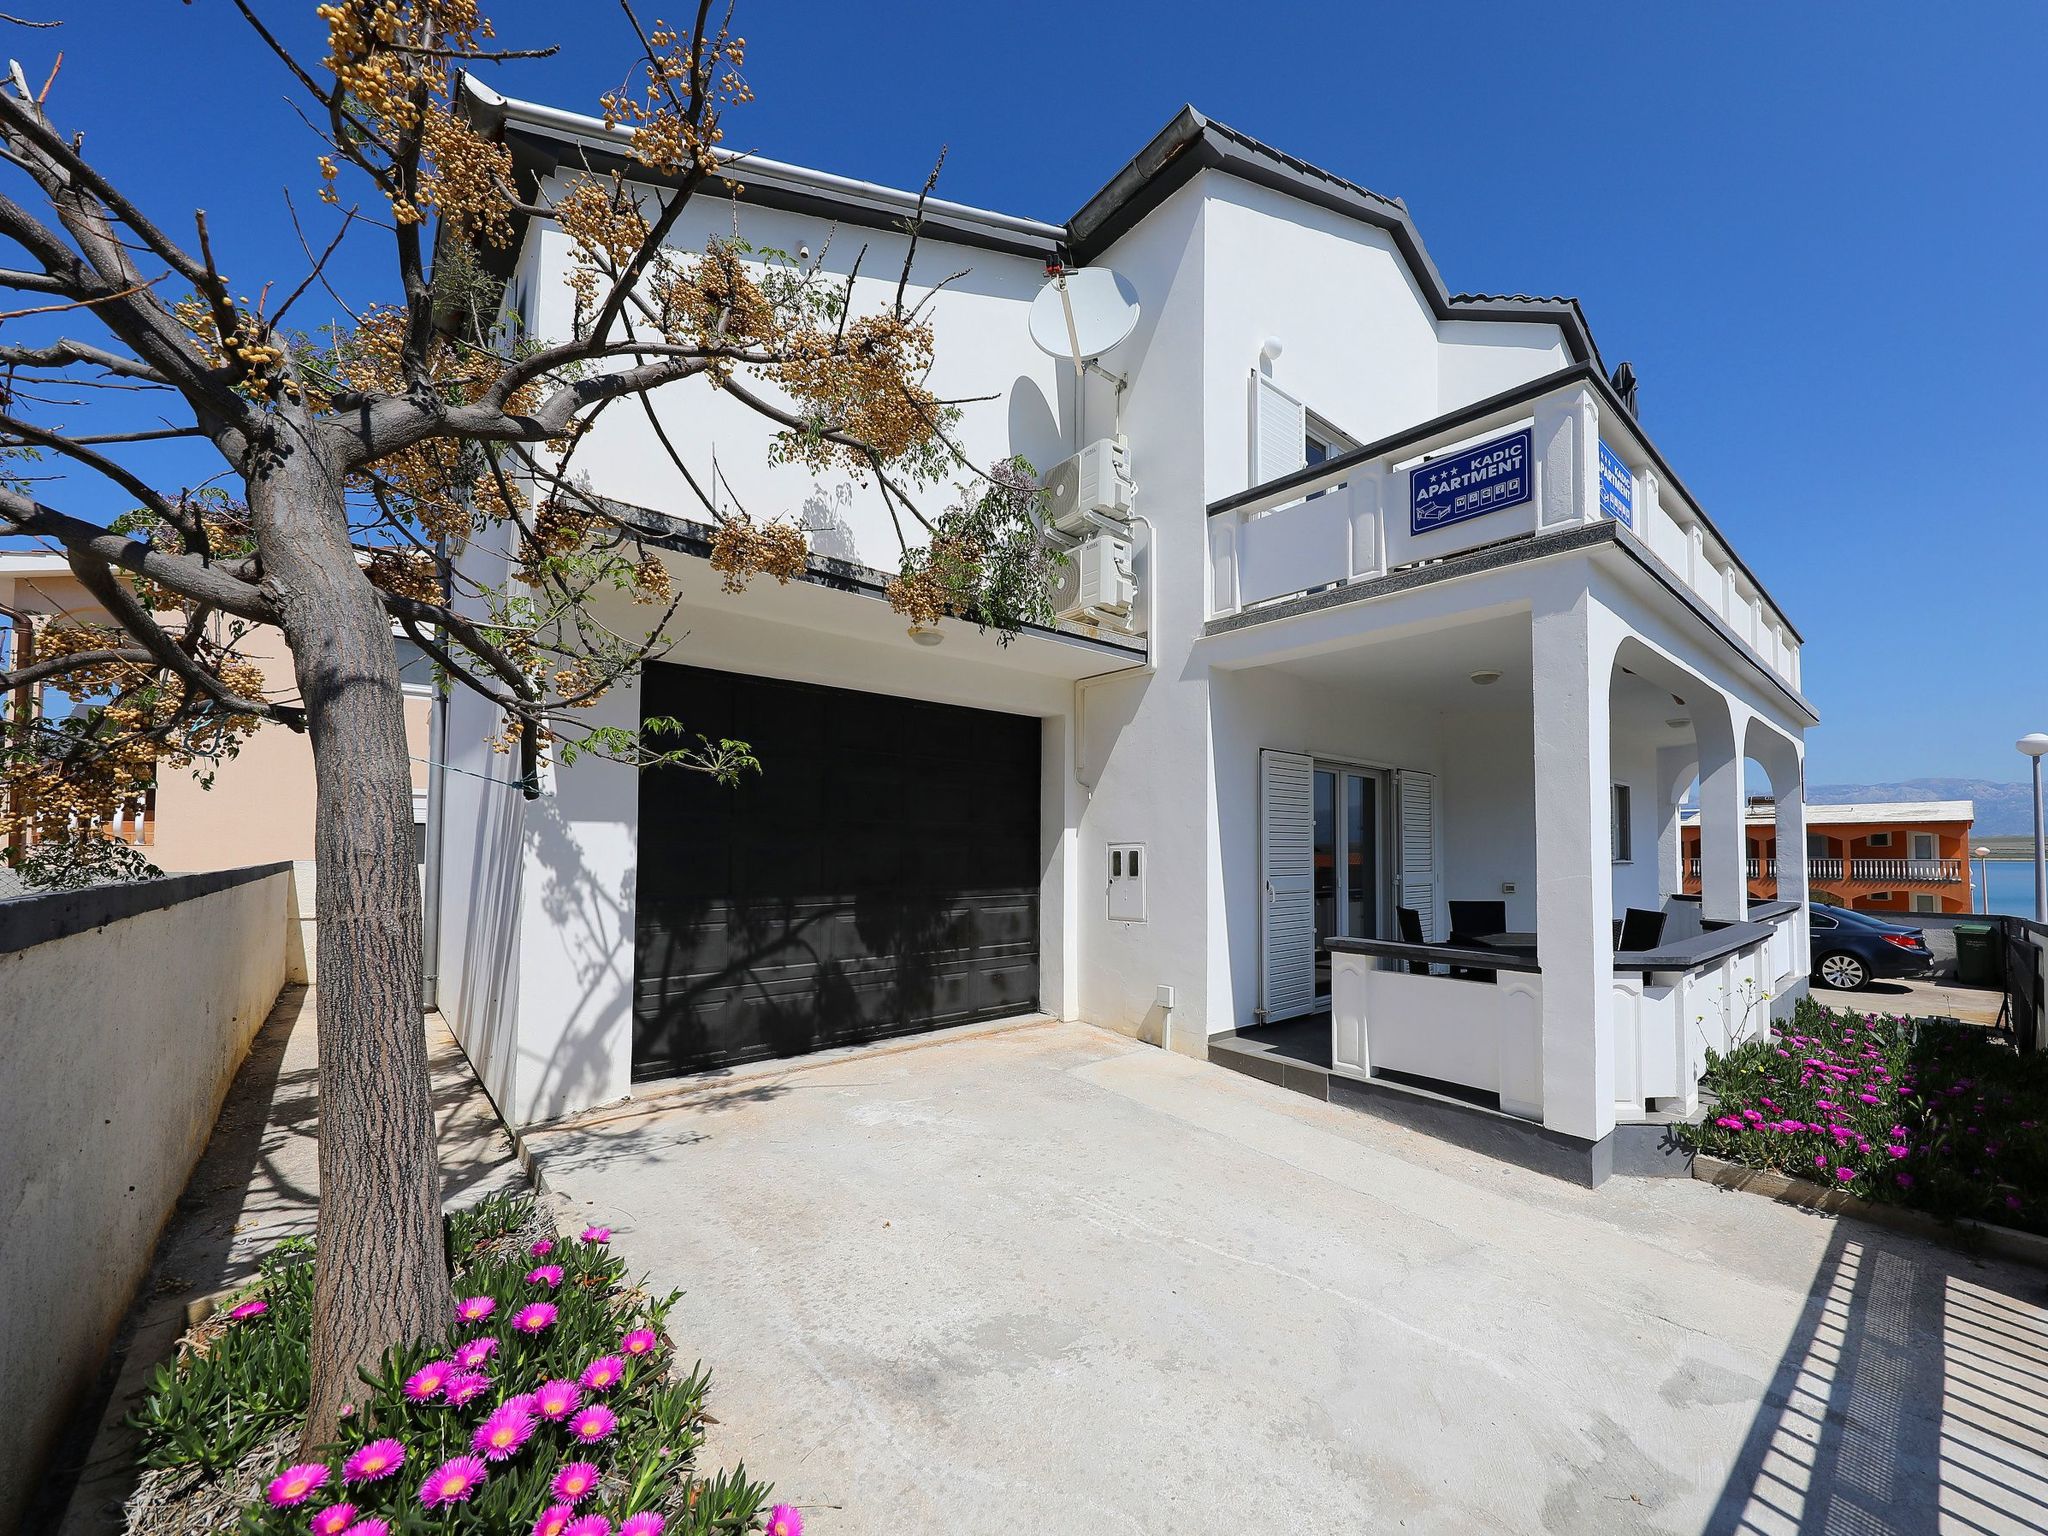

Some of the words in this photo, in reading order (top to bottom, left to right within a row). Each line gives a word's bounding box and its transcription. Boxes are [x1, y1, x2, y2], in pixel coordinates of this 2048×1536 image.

[1471, 445, 1521, 470] KADIC
[1416, 455, 1522, 502] APARTMENT
[1600, 462, 1630, 502] PARTMENT
